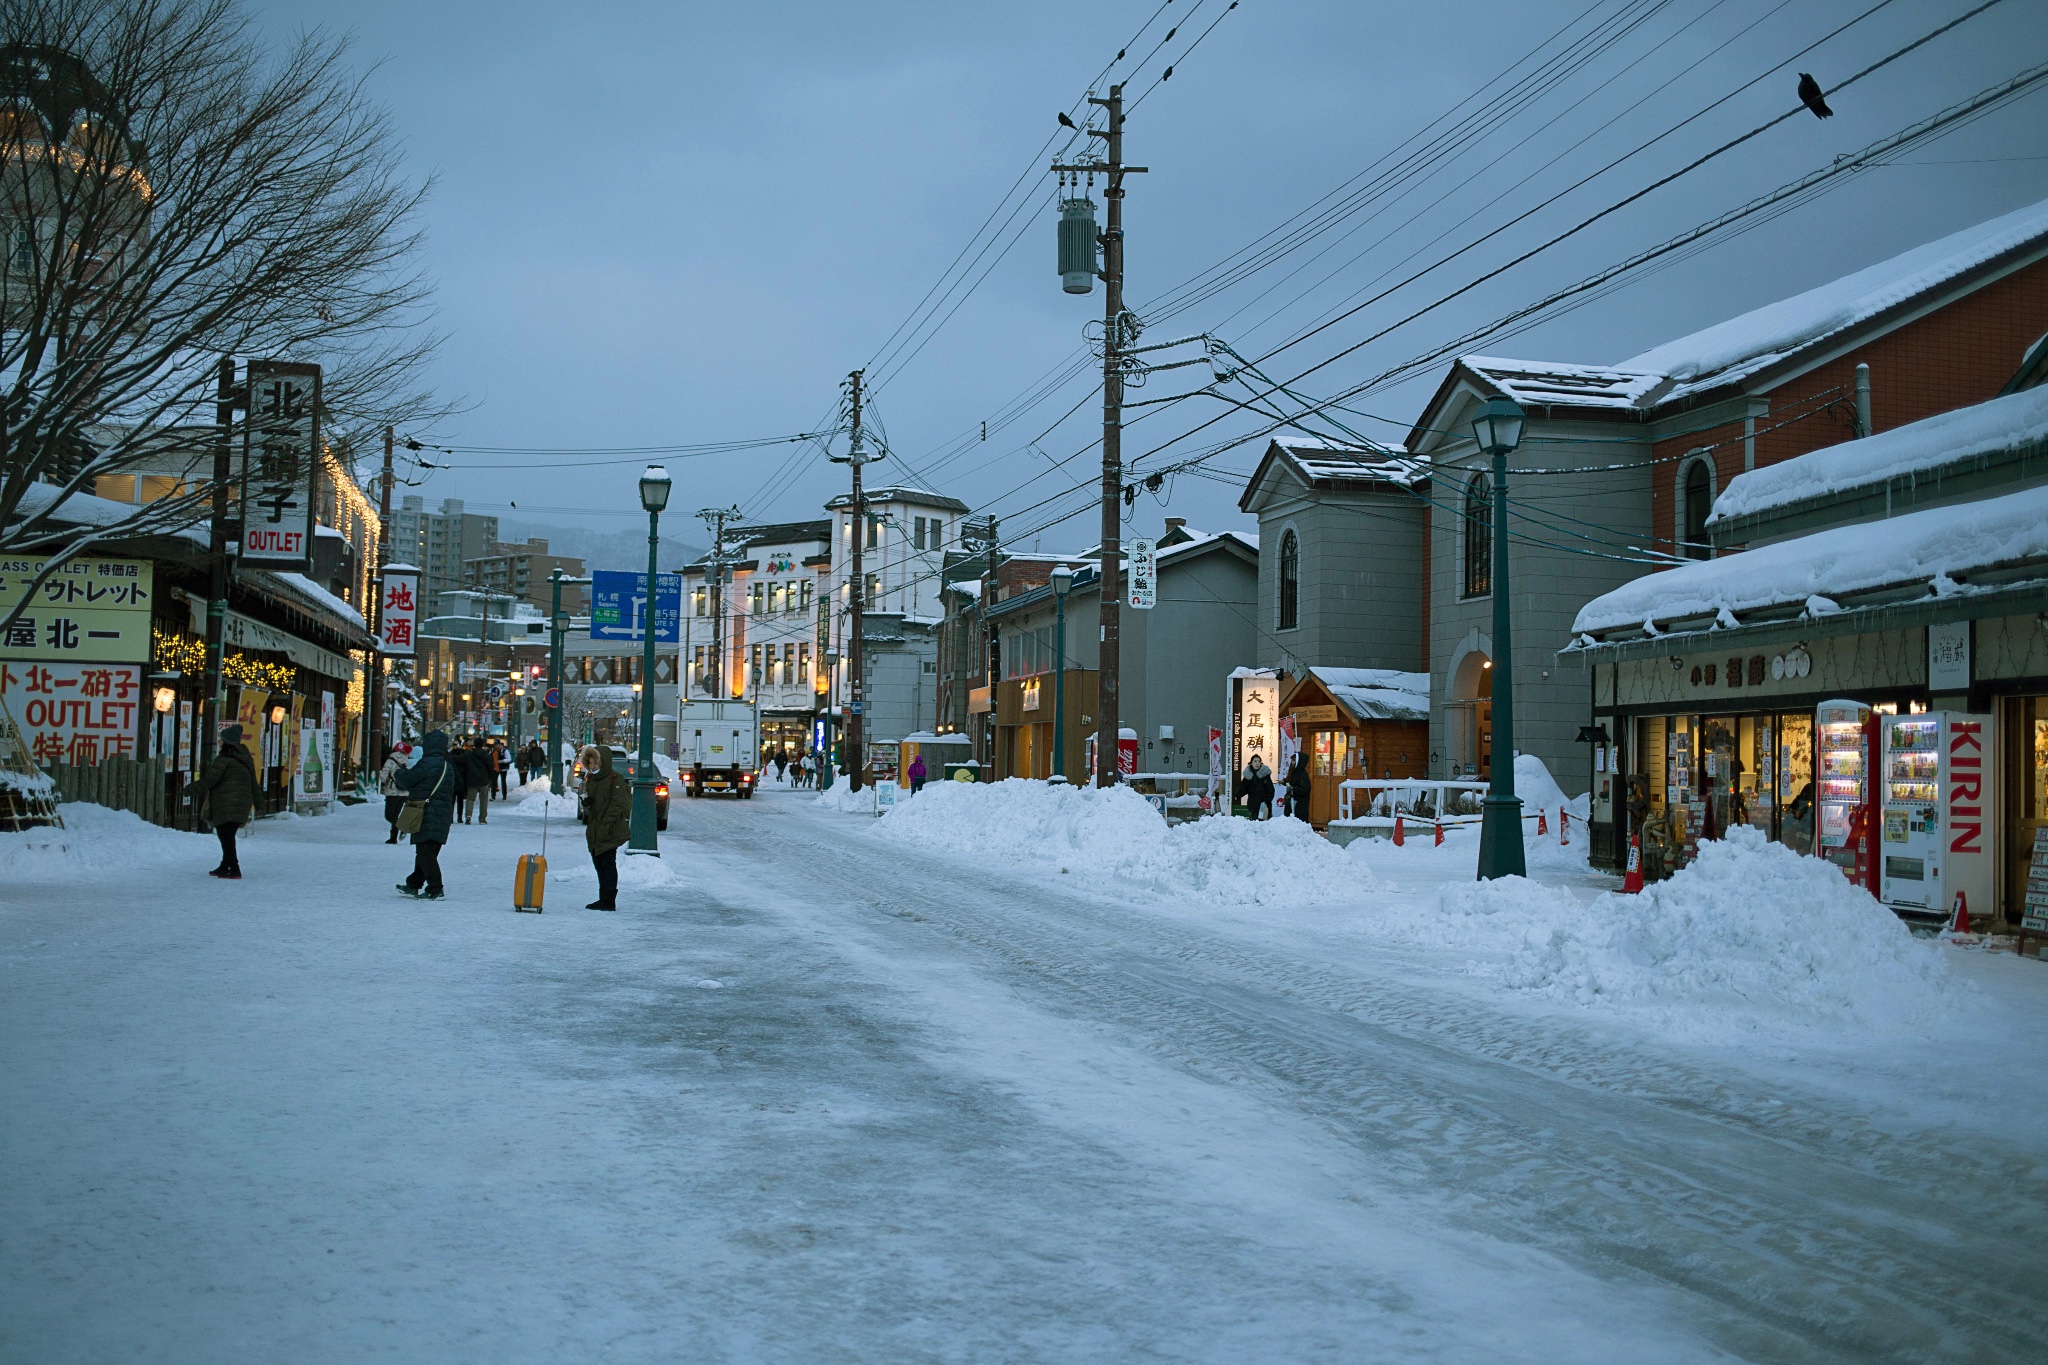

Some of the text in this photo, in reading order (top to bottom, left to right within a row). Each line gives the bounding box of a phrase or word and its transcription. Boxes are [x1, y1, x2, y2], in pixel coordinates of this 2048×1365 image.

[257, 381, 303, 523] 北一硝子
[248, 530, 303, 552] OUTLET
[34, 562, 91, 574] OTLET
[98, 563, 139, 577] 特価店
[637, 575, 679, 587] 南樽駅
[597, 592, 619, 602] 札幌
[384, 581, 414, 647] 地酒
[643, 608, 678, 620] 道5号
[3, 617, 120, 650] 屋北一
[25, 665, 139, 699] 北一硝子
[26, 699, 137, 730] OUTLET
[32, 731, 134, 767] 特価店
[1950, 722, 1982, 854] KIRIN
